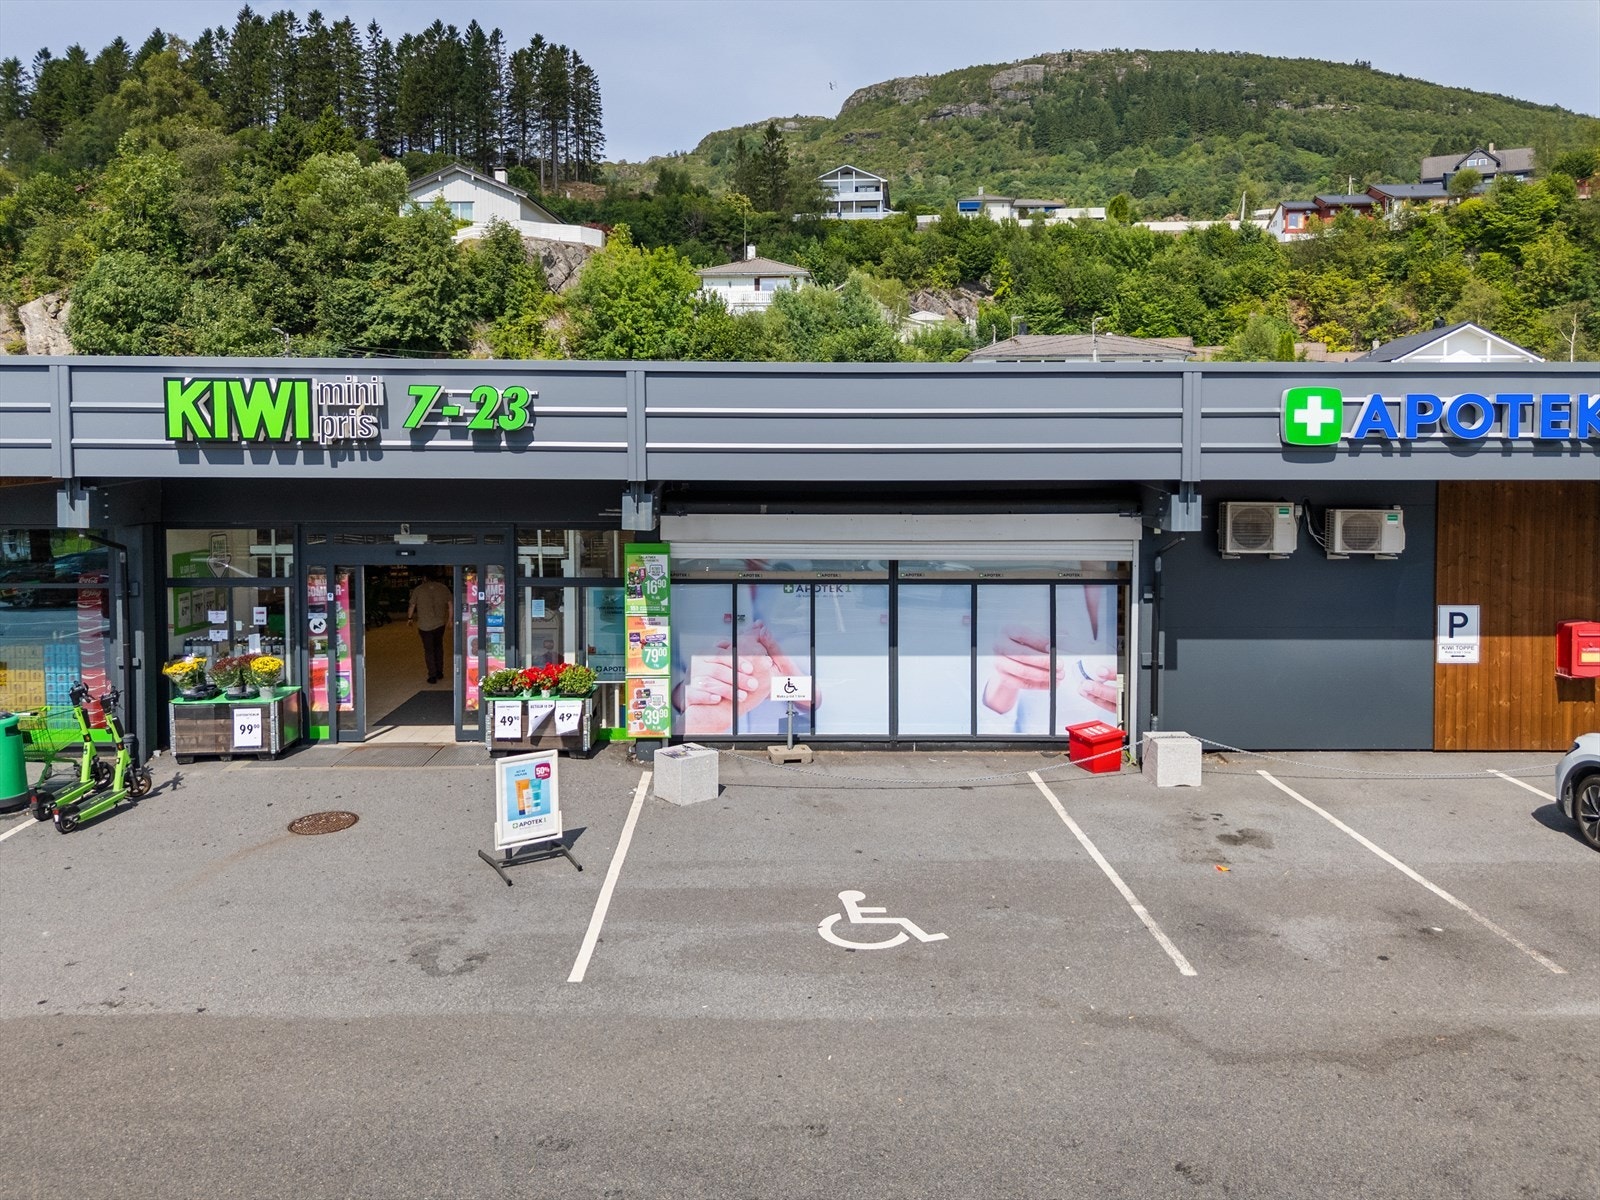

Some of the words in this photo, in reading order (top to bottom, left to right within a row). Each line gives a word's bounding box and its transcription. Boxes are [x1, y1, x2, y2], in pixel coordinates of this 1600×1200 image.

[318, 374, 379, 406] mini
[163, 377, 313, 440] KIWI
[1353, 393, 1600, 440] APOTEK
[319, 408, 373, 445] pris
[1449, 612, 1468, 638] P
[536, 766, 550, 775] 50%
[519, 818, 542, 828] APOTEK
